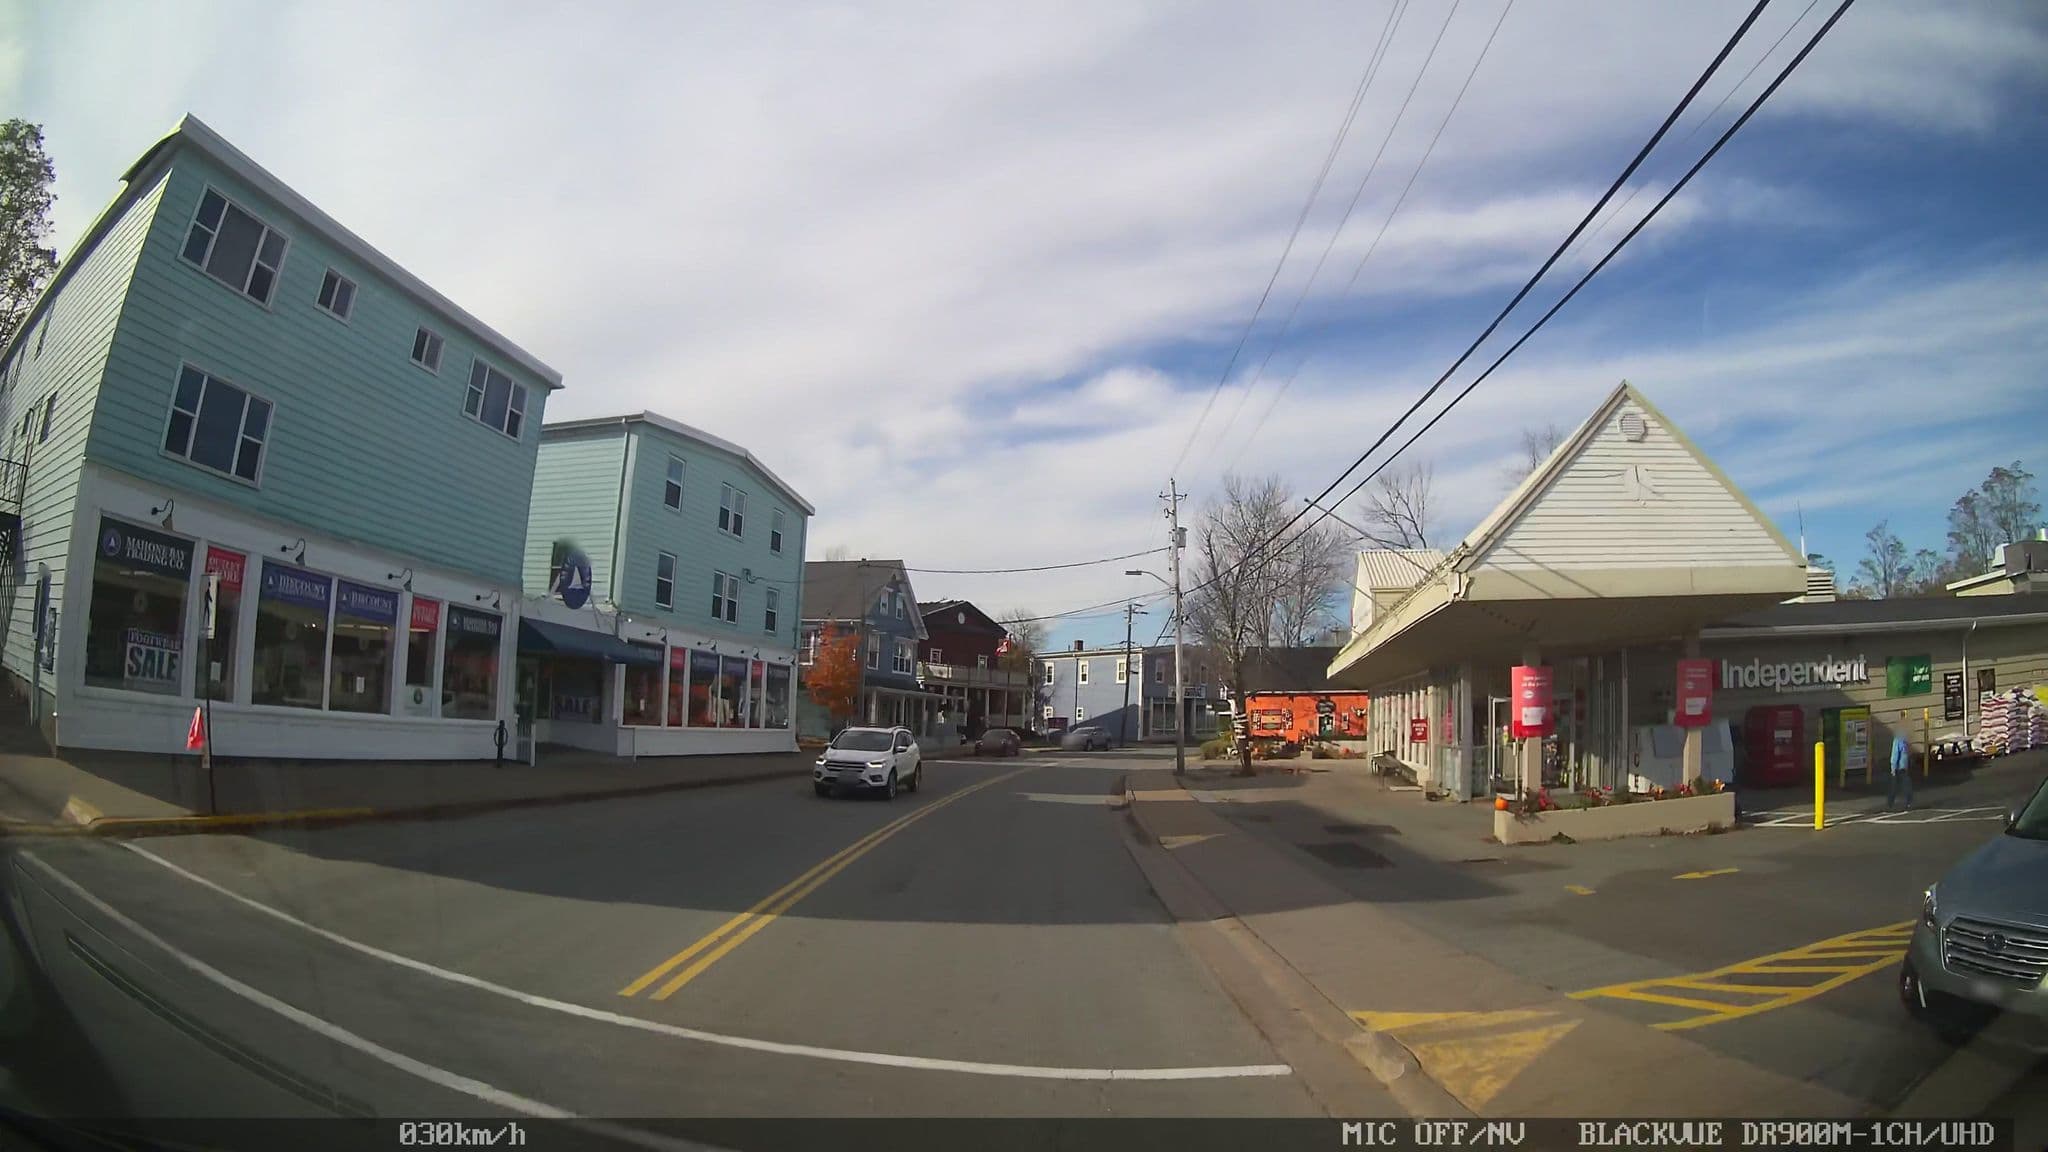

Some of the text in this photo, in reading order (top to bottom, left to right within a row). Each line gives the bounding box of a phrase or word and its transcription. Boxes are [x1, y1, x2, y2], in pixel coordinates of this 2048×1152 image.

[126, 536, 185, 561] MAHONE BAY
[126, 547, 168, 566] TRADING
[126, 646, 179, 682] SALE
[1721, 653, 1869, 693] Independent
